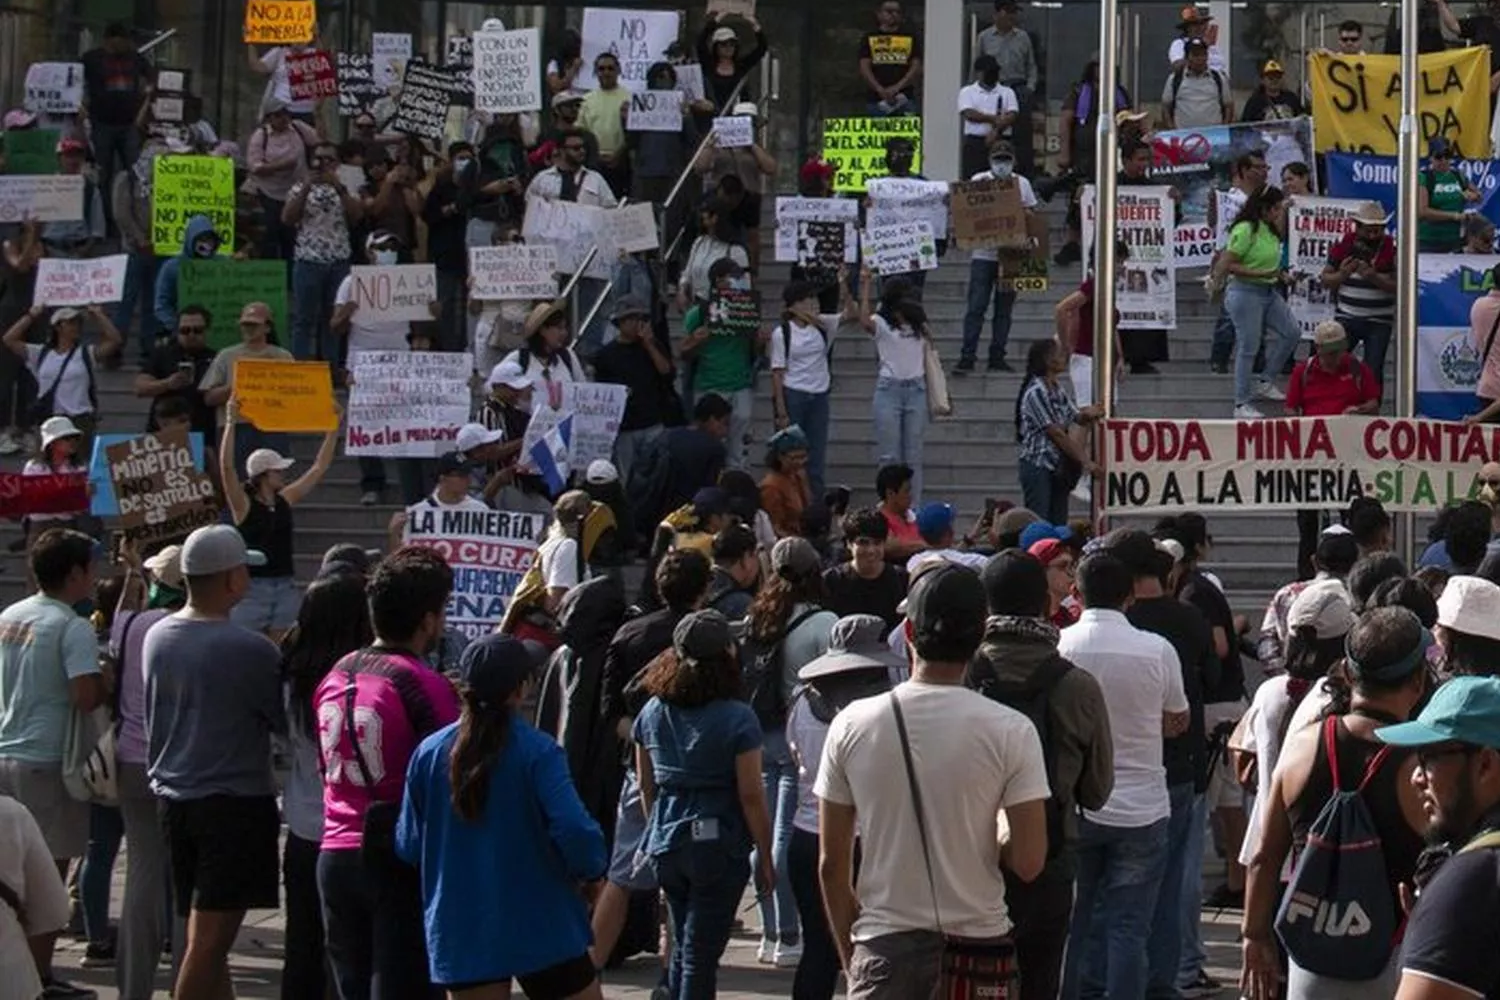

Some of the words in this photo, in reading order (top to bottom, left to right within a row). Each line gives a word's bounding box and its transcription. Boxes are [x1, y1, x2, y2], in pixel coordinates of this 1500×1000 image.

[251, 6, 281, 21] NO
[621, 19, 646, 40] NO
[479, 36, 507, 51] CON
[509, 35, 528, 49] UN
[629, 42, 649, 58] LA
[1422, 65, 1464, 95] LA
[632, 93, 656, 112] NO
[1382, 107, 1463, 144] VDA
[837, 173, 854, 187] DE
[156, 208, 177, 223] NO
[1115, 205, 1162, 221] UERTE
[1295, 215, 1311, 231] LA
[1314, 215, 1356, 233] MUER
[1116, 227, 1165, 247] ENTAN
[357, 273, 391, 310] NO
[350, 425, 371, 447] No
[386, 425, 402, 444] la
[1107, 420, 1211, 462] TODA
[1237, 418, 1336, 461] MINA
[121, 478, 153, 497] NO
[1107, 471, 1150, 506] NO
[1160, 471, 1184, 505] A
[1197, 470, 1242, 504] LA
[1255, 463, 1364, 504] MINERÍA
[1412, 470, 1437, 506] A
[410, 510, 435, 534] LA
[459, 541, 536, 569] CURA
[1286, 890, 1372, 937] FILA
